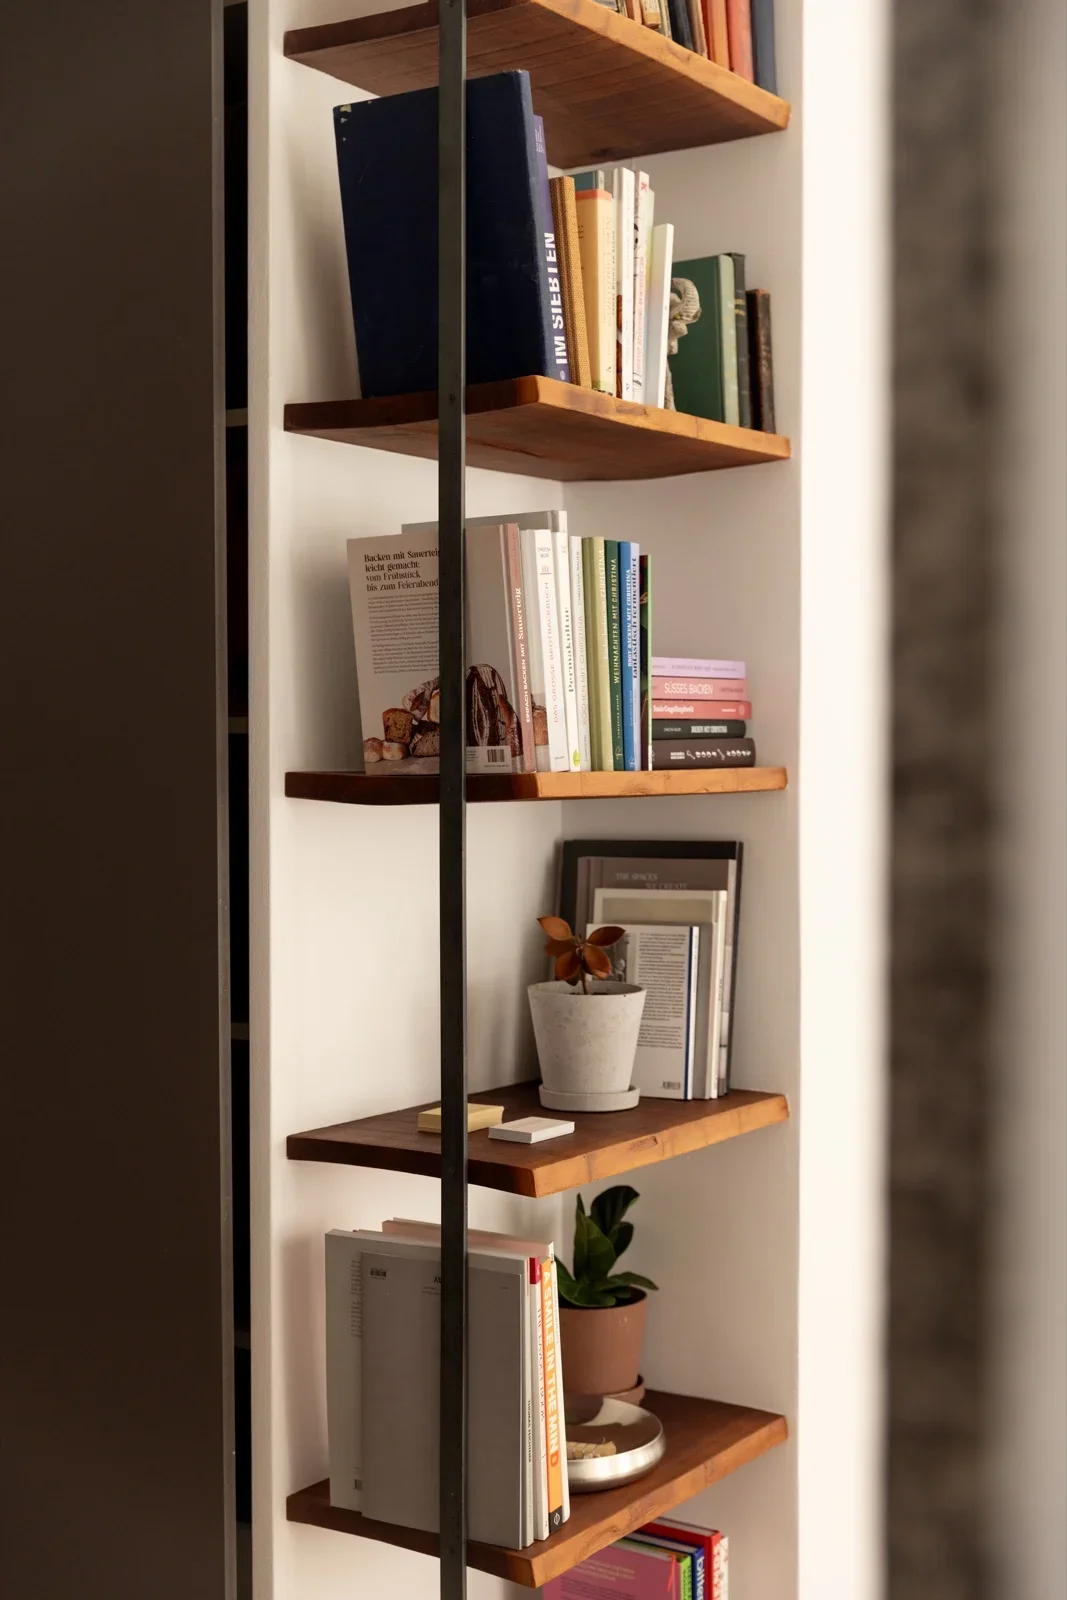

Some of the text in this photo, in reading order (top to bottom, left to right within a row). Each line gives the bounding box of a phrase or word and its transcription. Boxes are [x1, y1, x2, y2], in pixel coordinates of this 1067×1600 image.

[554, 336, 568, 365] IM
[364, 553, 390, 563] Backen
[393, 551, 405, 560] mit
[365, 561, 421, 572] leicht gemacht:
[366, 570, 421, 582] vom Frühstück
[366, 583, 378, 592] bis
[380, 583, 395, 591] zum
[514, 587, 524, 640] Sauerteig
[612, 622, 620, 684] WEIHNACHTEN
[550, 664, 558, 702] GROSSE
[522, 691, 531, 723] EINFACH
[615, 872, 658, 881] THE SPACES
[543, 1271, 559, 1468] A SMILE IN THE MIND
